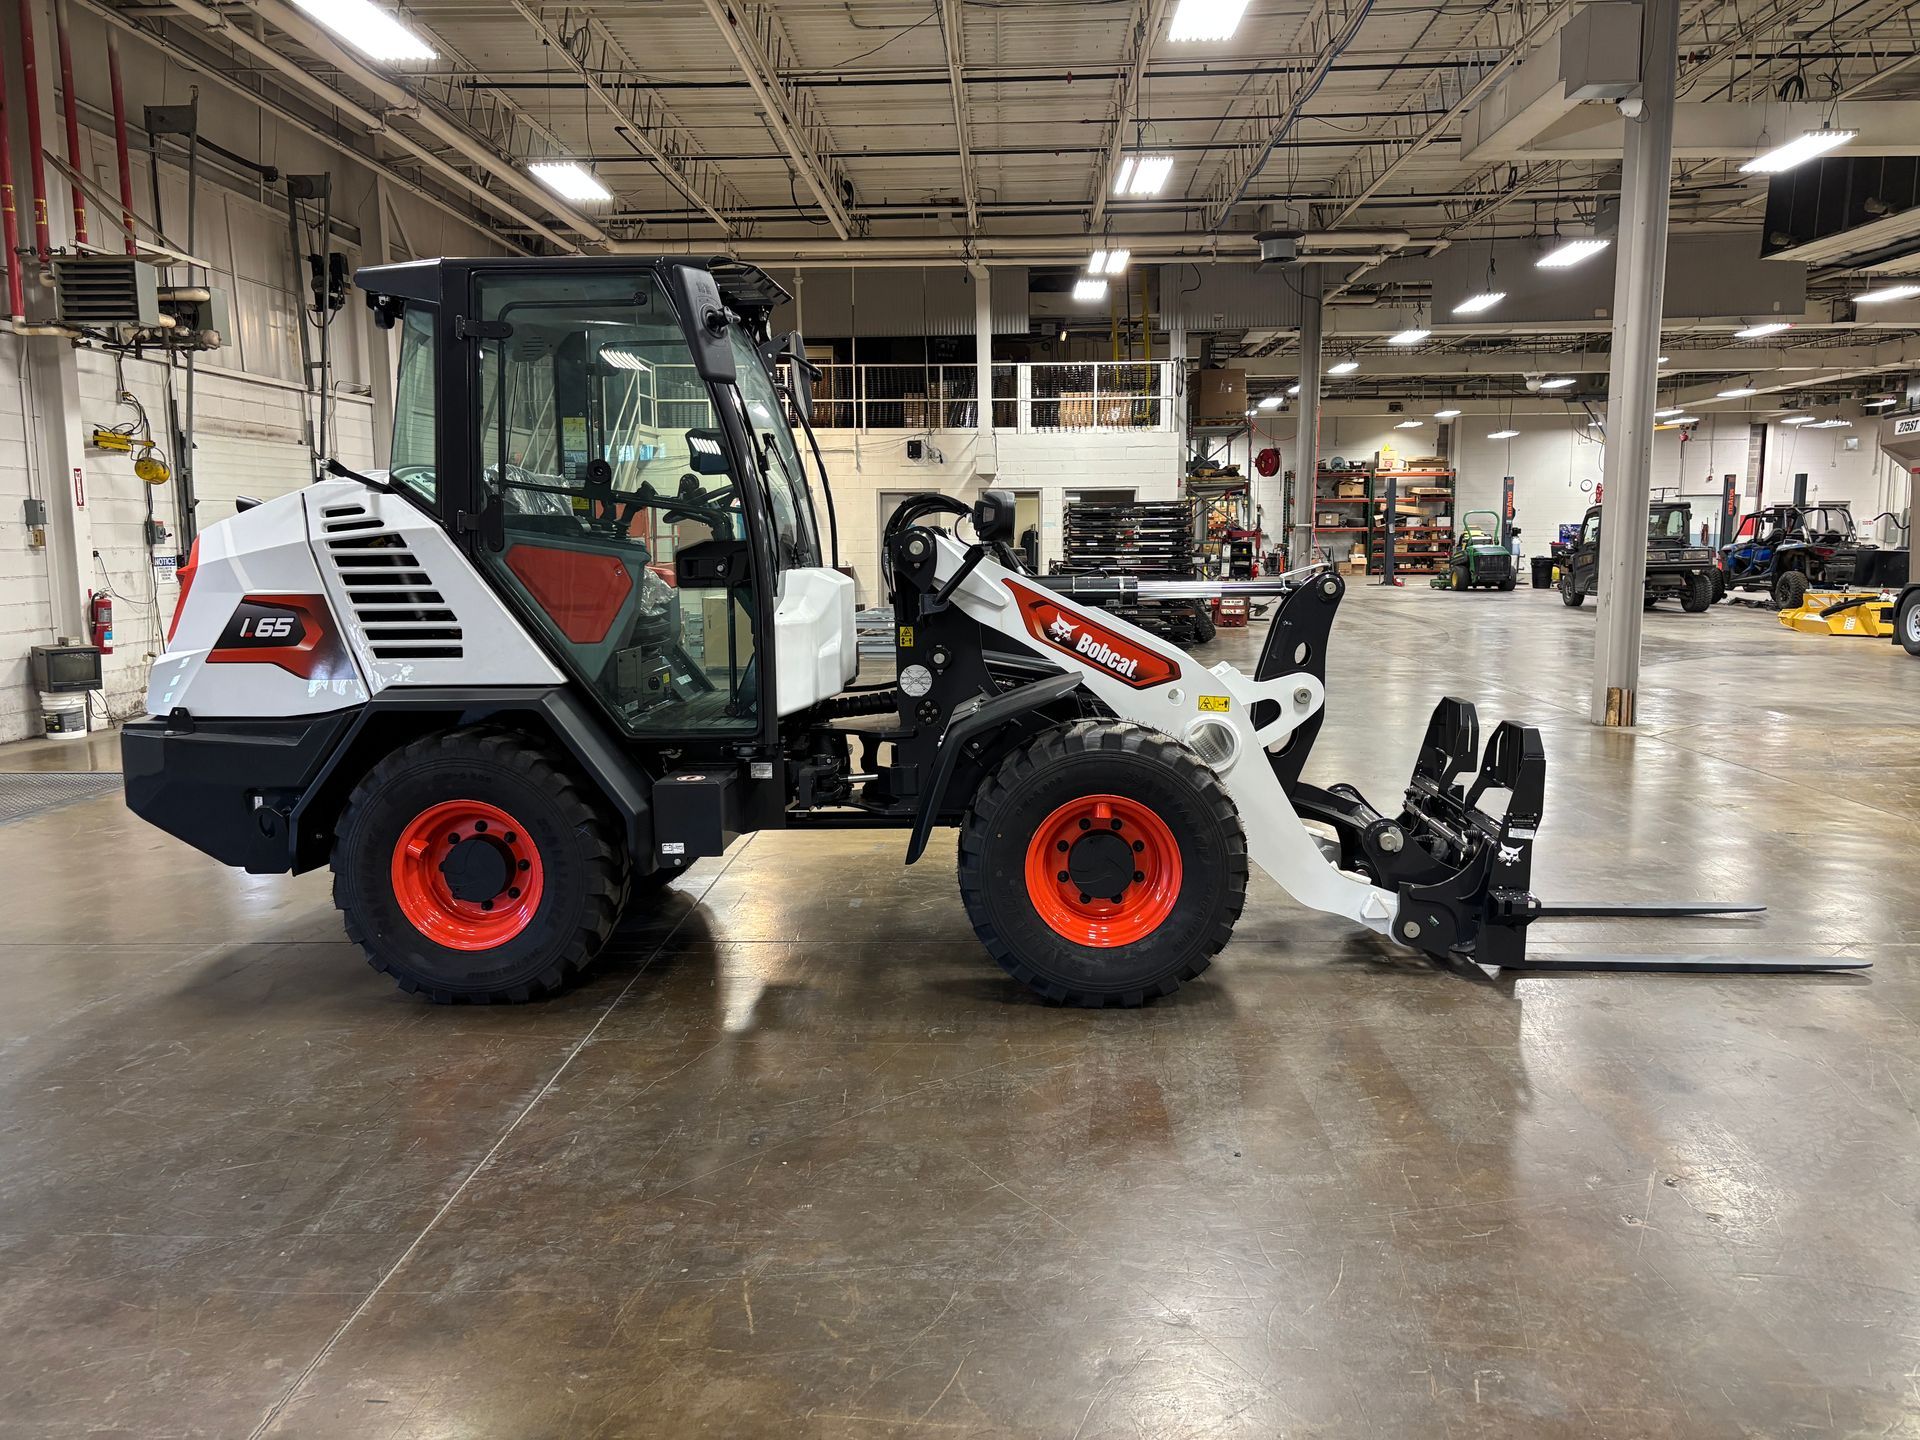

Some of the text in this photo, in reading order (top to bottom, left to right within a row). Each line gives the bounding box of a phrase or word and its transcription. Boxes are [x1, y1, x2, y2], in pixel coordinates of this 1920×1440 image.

[1897, 419, 1919, 433] 275ST
[154, 557, 175, 566] NOTICE
[1075, 632, 1138, 678] Bobcat
